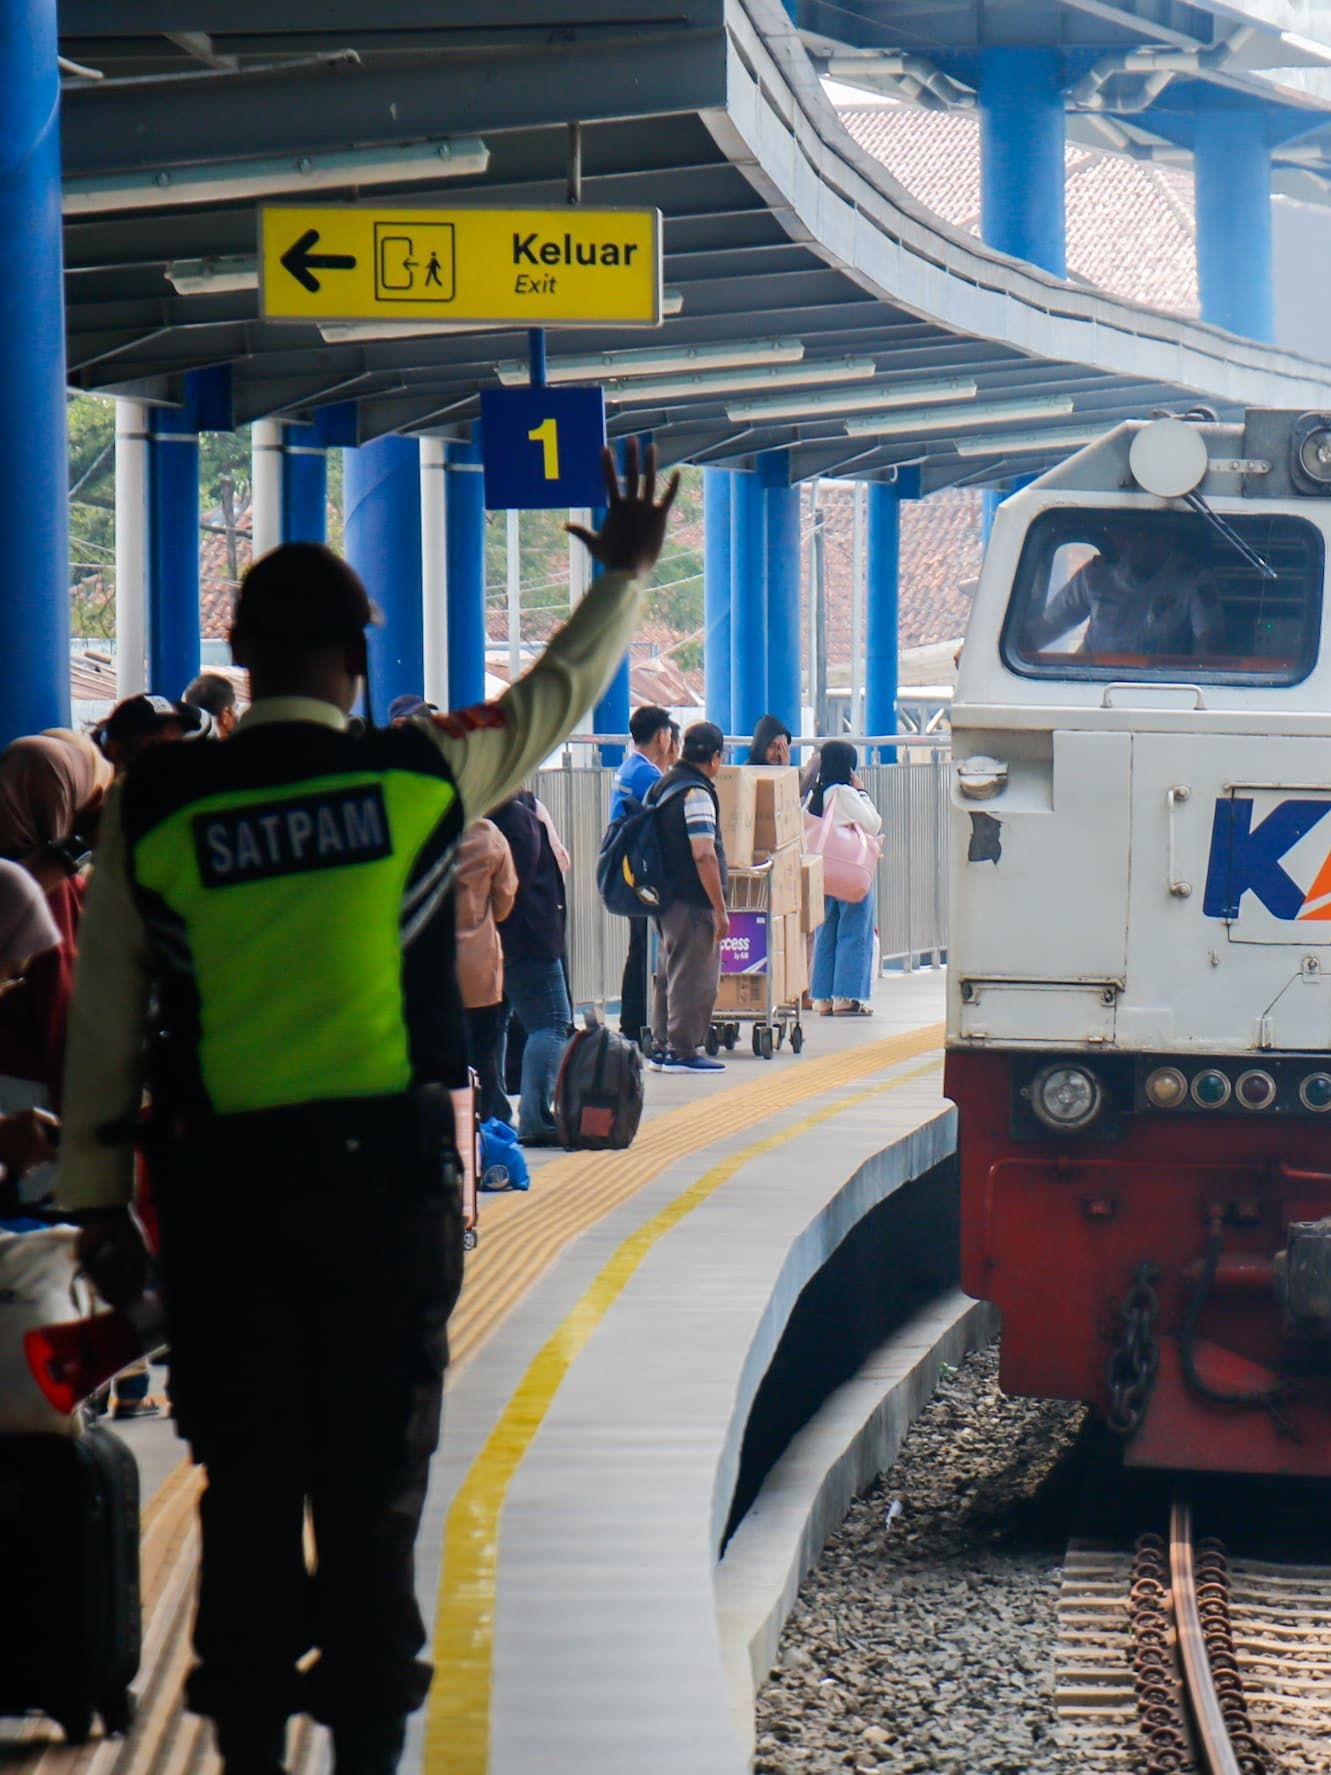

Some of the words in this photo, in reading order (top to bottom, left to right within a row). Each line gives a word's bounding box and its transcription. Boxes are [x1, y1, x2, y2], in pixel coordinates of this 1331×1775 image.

[512, 233, 638, 266] Keluar
[514, 273, 557, 294] Exit
[528, 418, 559, 479] 1
[206, 797, 384, 873] SATPAM
[720, 937, 750, 950] ccess
